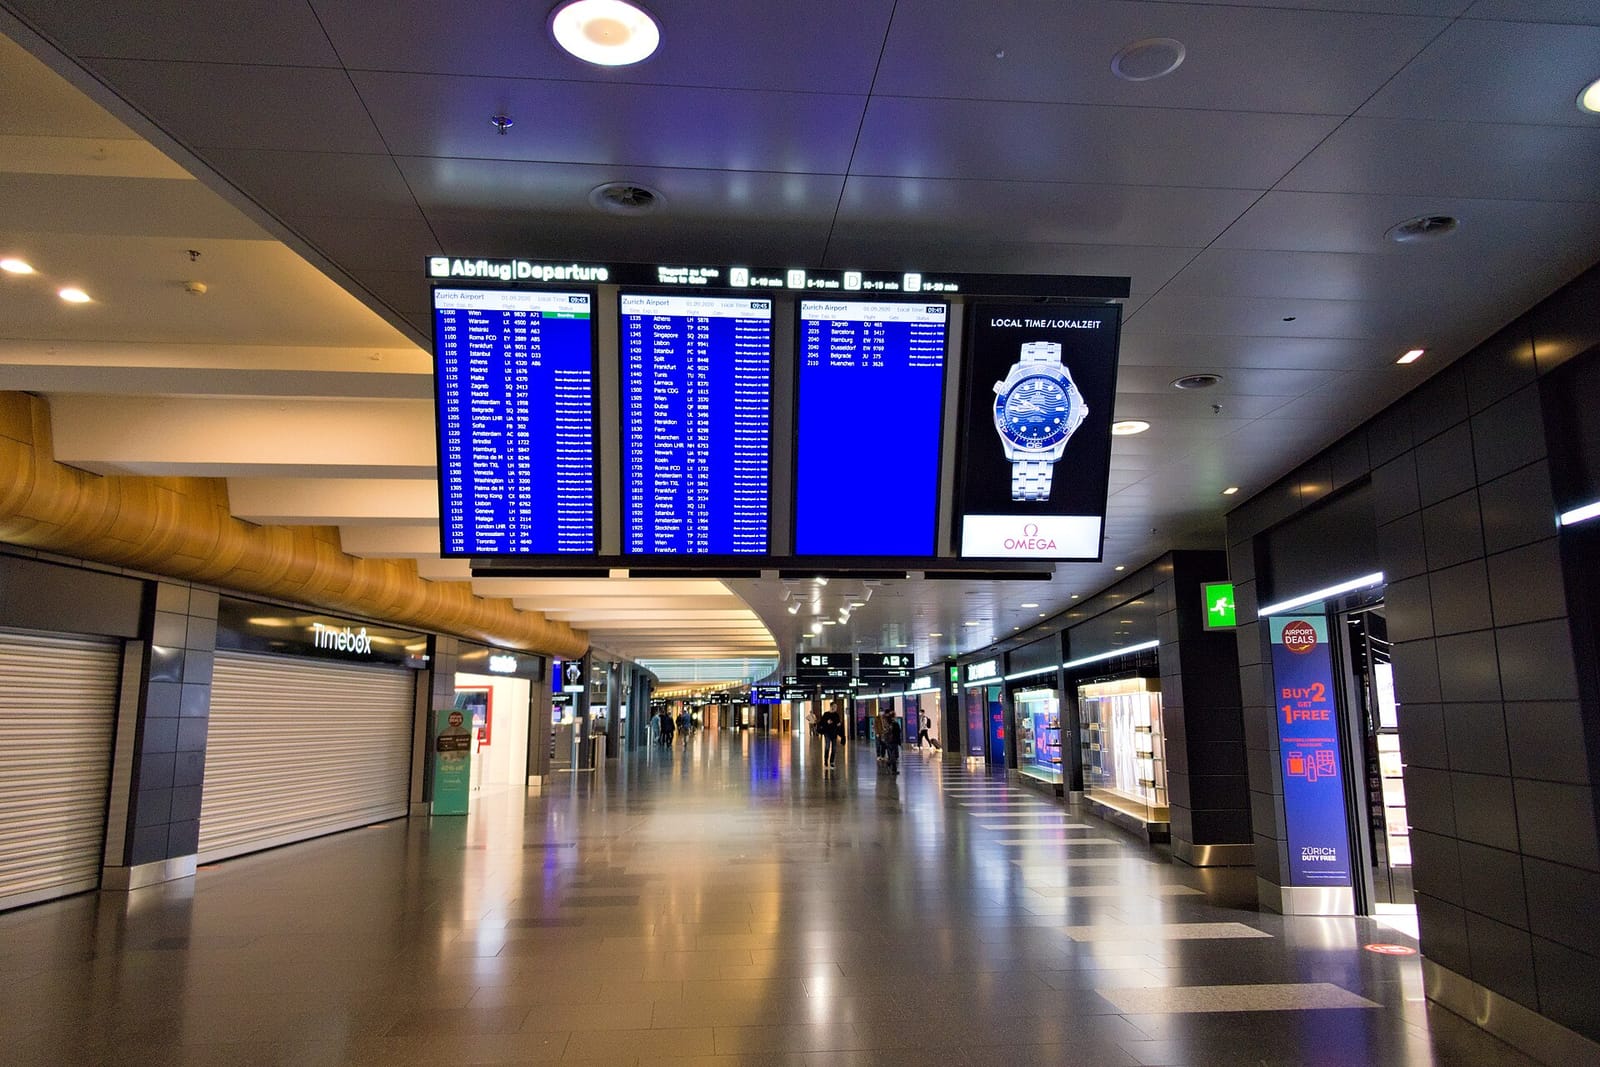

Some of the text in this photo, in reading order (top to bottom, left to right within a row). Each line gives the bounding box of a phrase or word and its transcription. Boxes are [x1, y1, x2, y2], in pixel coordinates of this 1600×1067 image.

[451, 260, 608, 281] Abflug Departure
[991, 318, 1102, 329] LOCAL TIME/LOKALZEIT
[1004, 538, 1057, 550] OMEGA
[313, 622, 372, 654] Timebox
[1285, 635, 1314, 644] DEALS
[822, 656, 828, 666] E
[882, 656, 890, 666] A
[1282, 682, 1326, 702] BUY 2
[1282, 704, 1292, 724] 1
[1302, 846, 1336, 855] ZÜRICH
